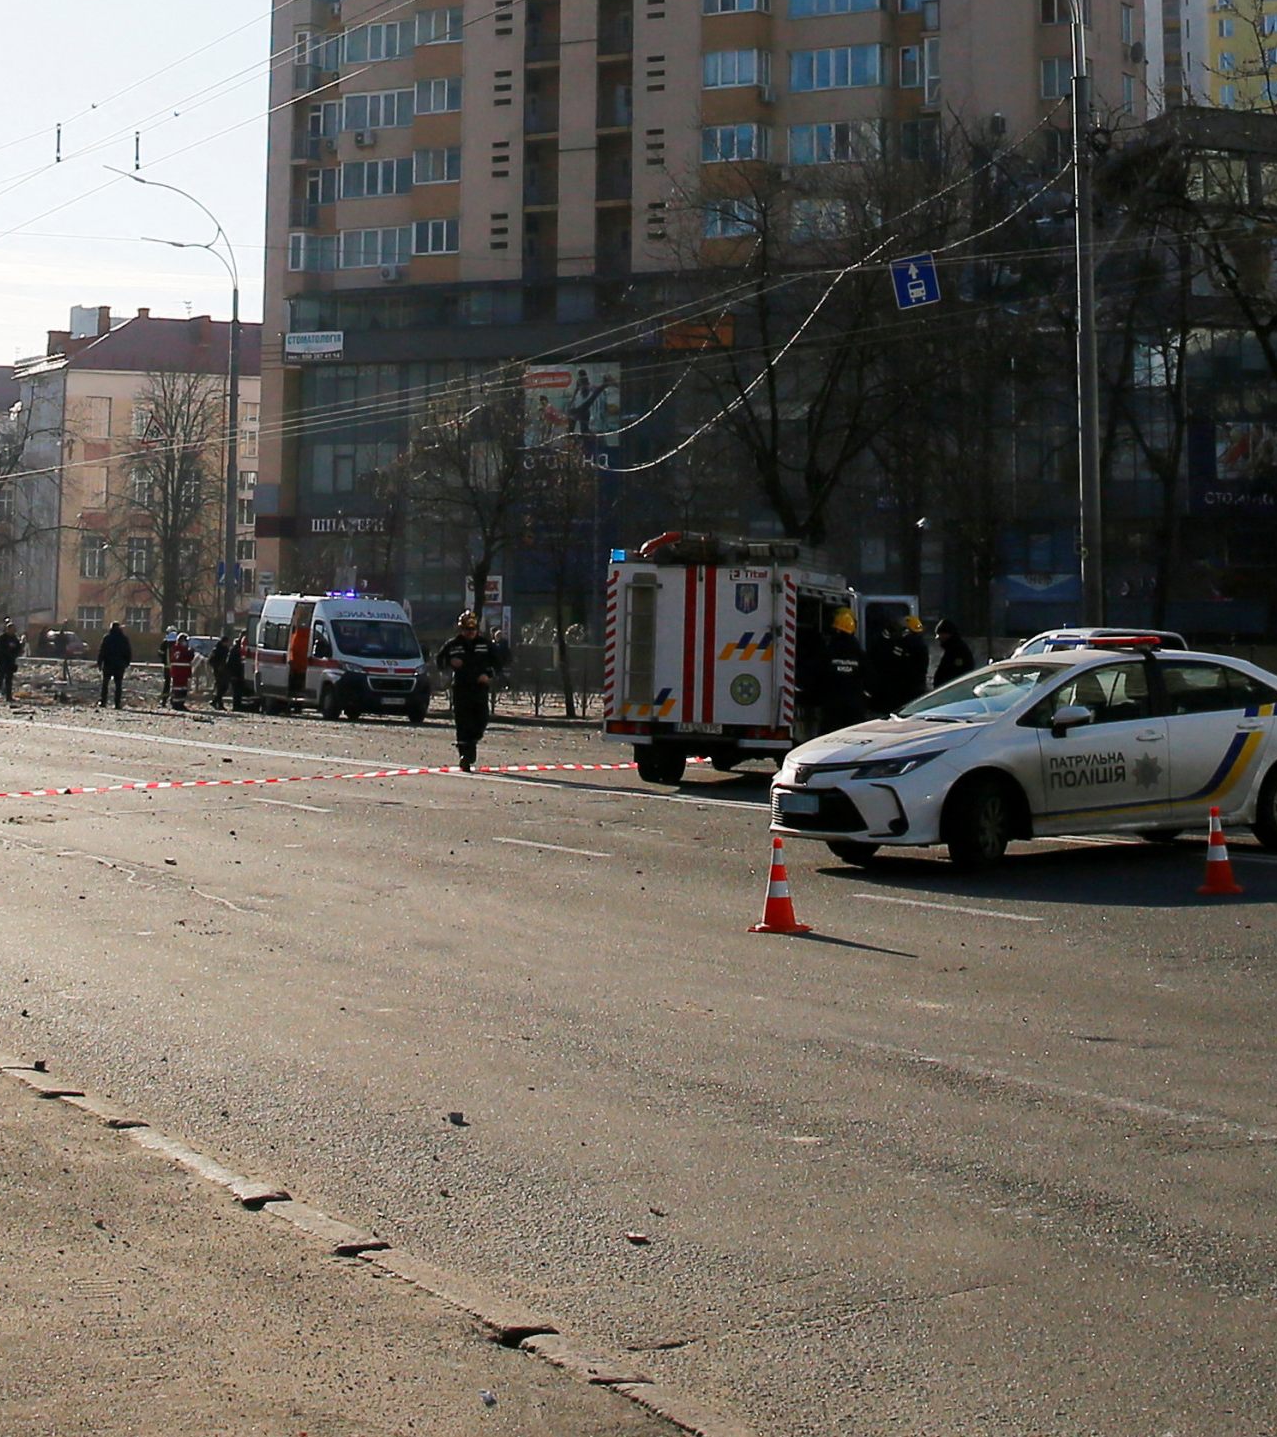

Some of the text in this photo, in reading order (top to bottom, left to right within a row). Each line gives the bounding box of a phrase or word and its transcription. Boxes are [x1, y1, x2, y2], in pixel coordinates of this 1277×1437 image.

[287, 334, 342, 345] СТОМАТОЛОГІЯ
[1050, 752, 1125, 769] ПАТРУЛЬНА
[1051, 766, 1126, 788] ПОЛІЦІЯ
